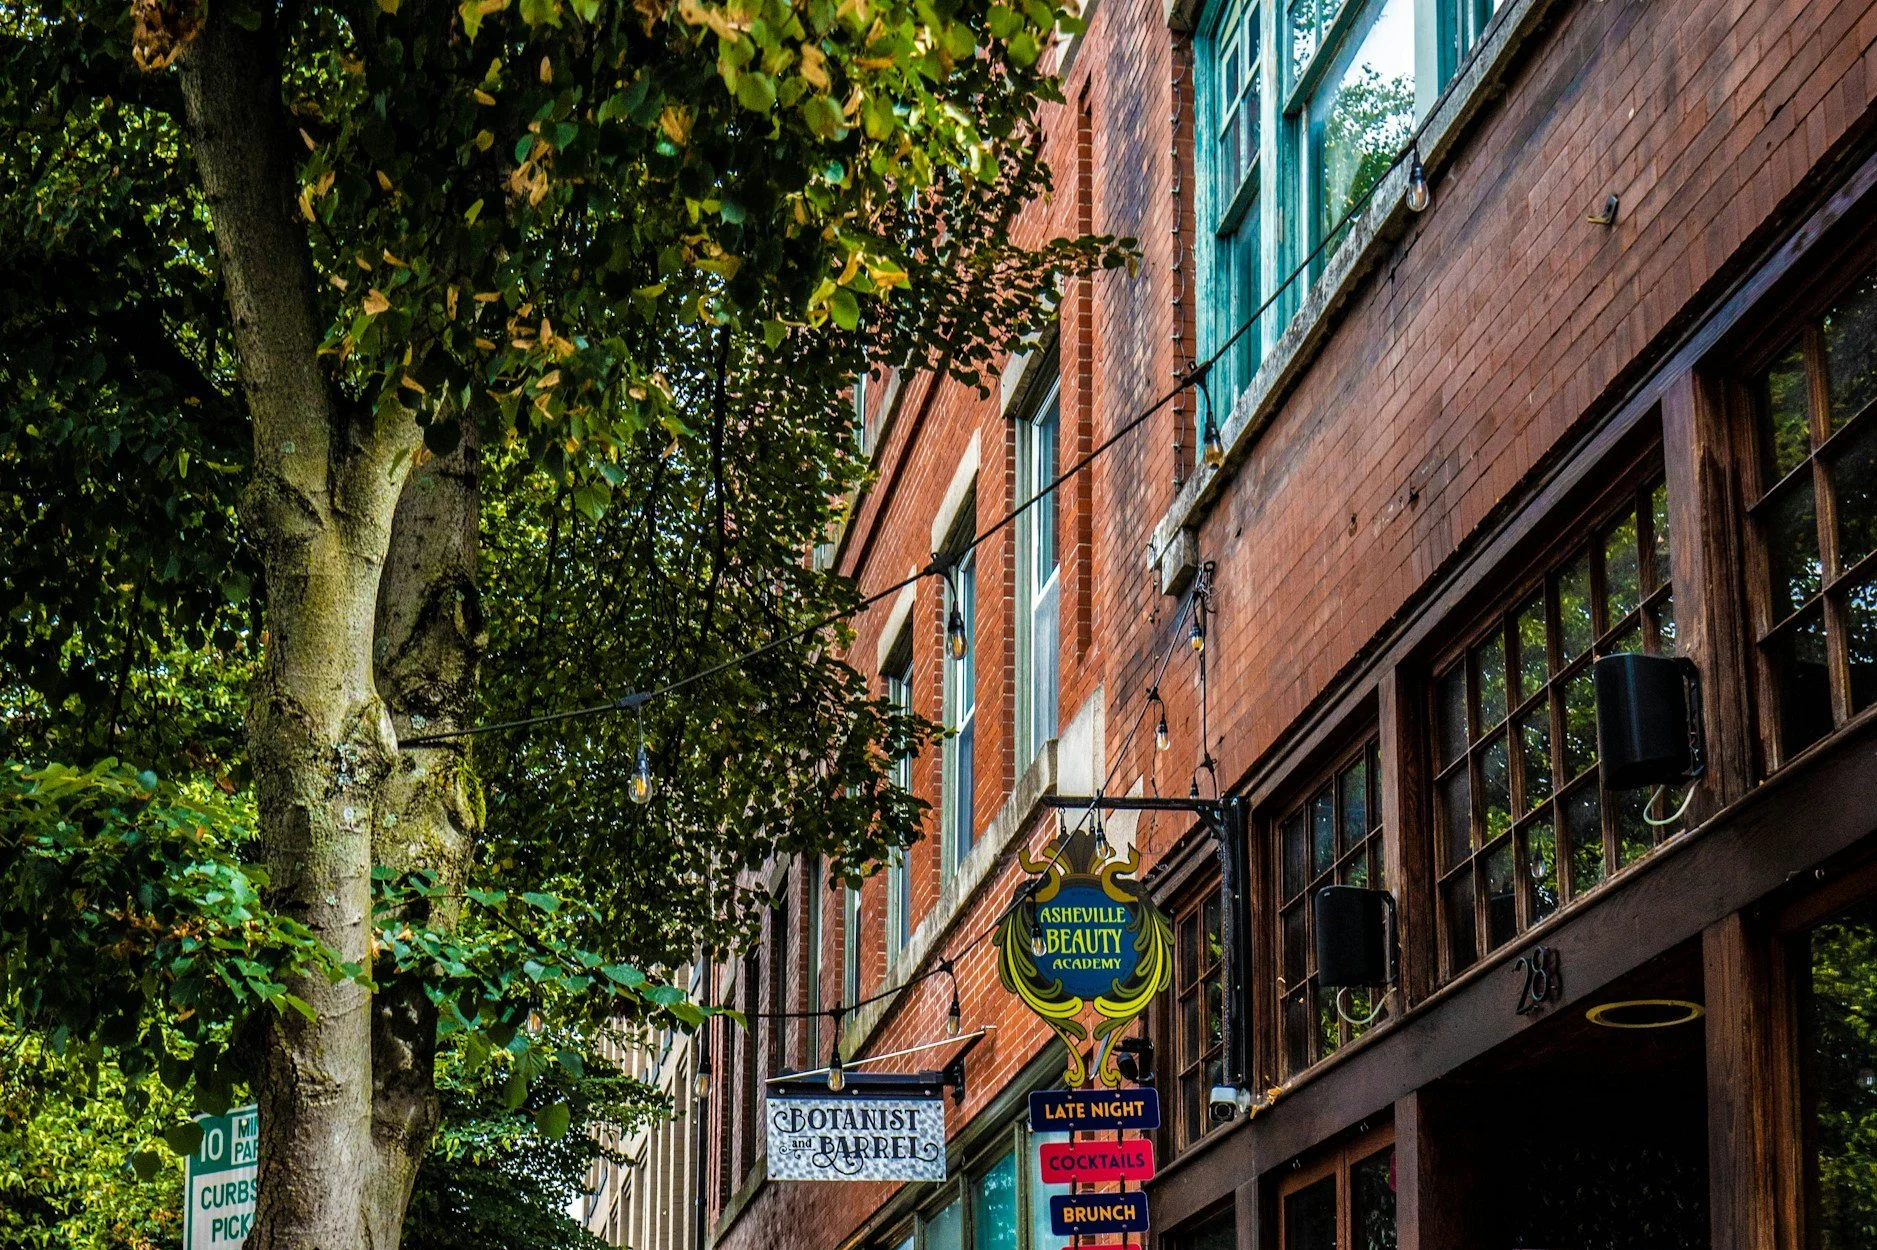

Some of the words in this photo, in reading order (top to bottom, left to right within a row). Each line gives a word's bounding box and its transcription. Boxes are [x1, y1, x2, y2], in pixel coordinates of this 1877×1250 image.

[1040, 907, 1126, 924] ASHEVILLE
[1046, 928, 1121, 954] BEAUTY
[1052, 958, 1121, 969] ACADEMY
[1045, 1104, 1086, 1119] LATE
[1091, 1101, 1145, 1118] NIGHT
[773, 1108, 920, 1133] BOTANIST
[200, 1128, 224, 1162] 10
[792, 1138, 812, 1149] and
[812, 1136, 938, 1168] BARREL
[1049, 1153, 1145, 1171] COCKTAILS
[1063, 1205, 1136, 1223] BRUNCH
